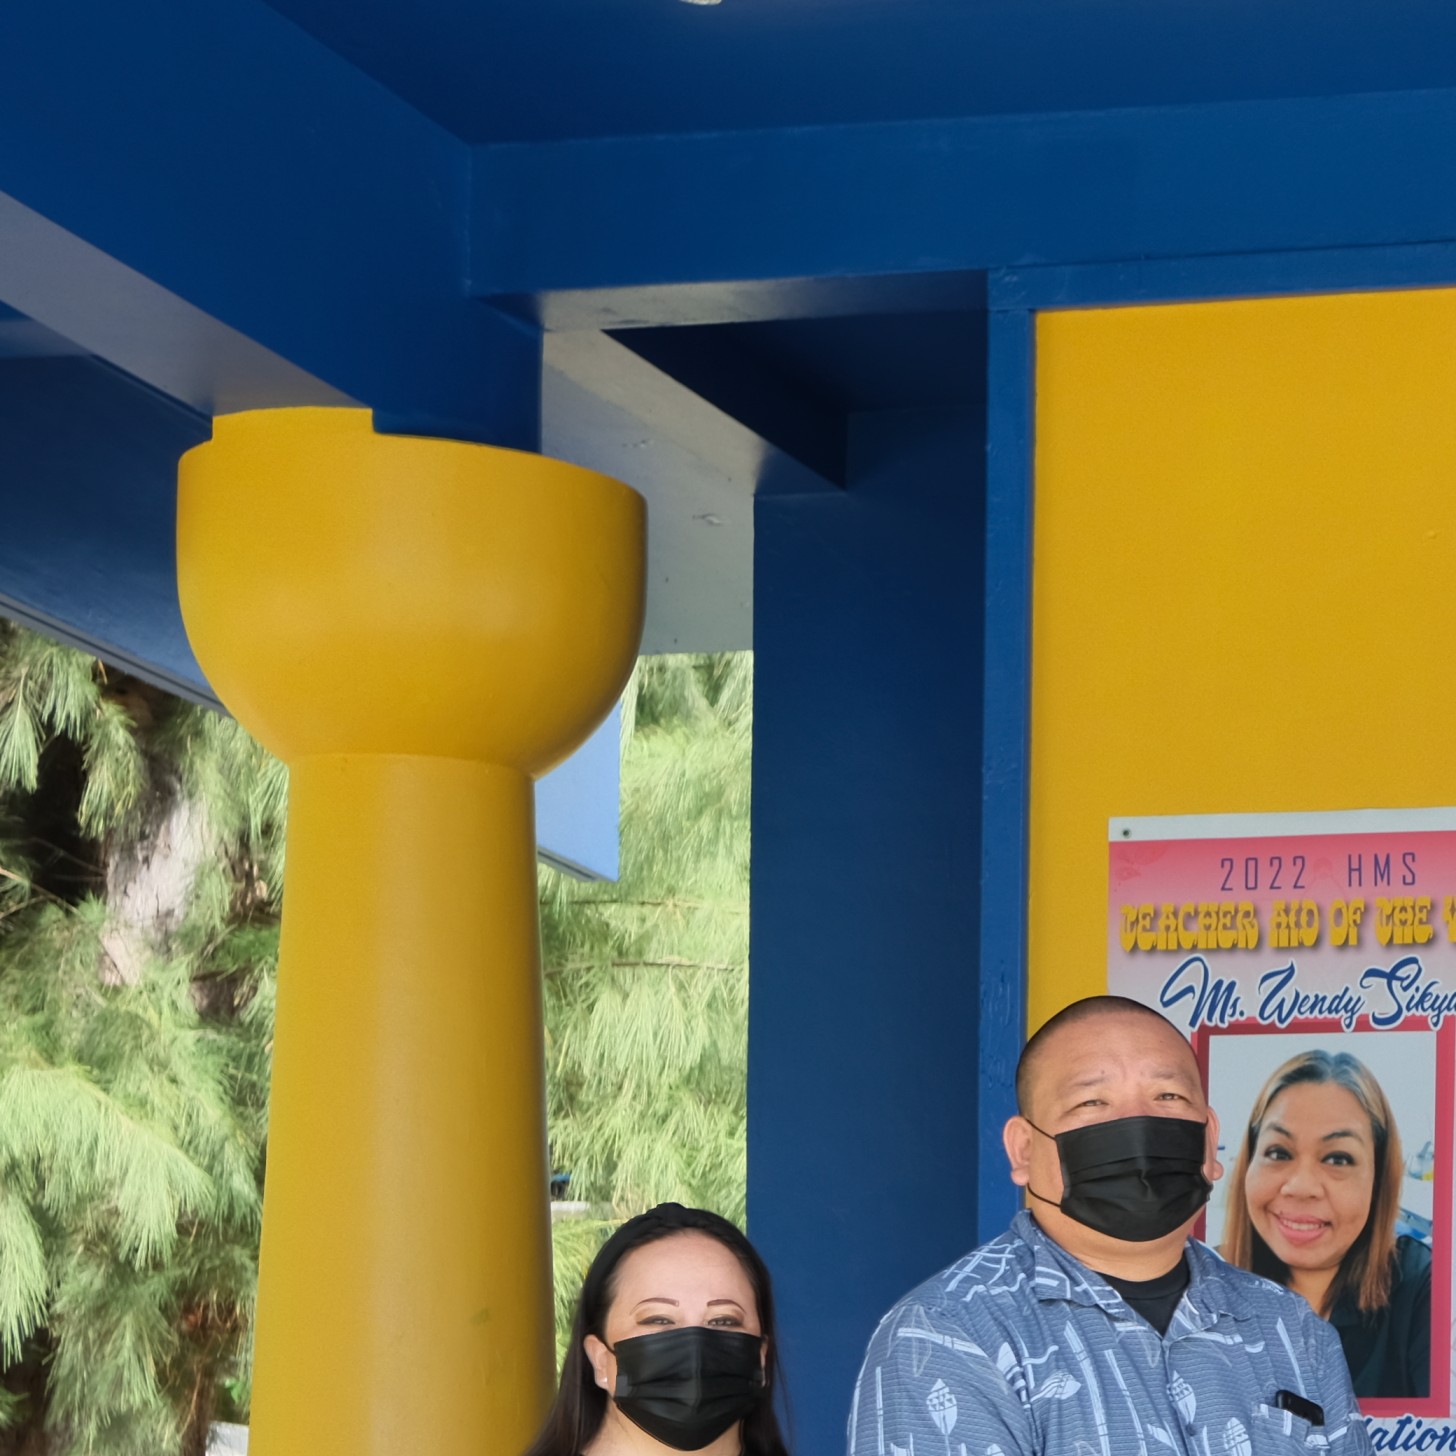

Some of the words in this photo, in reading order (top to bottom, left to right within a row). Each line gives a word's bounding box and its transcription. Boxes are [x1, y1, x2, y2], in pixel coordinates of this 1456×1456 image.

[1221, 856, 1307, 891] 2022
[1348, 852, 1417, 887] HMS
[1120, 902, 1259, 952] TEACHER
[1269, 898, 1319, 947] AID
[1328, 898, 1366, 945] OF
[1375, 896, 1434, 945] THE
[1160, 956, 1245, 1029] Ms.
[1259, 960, 1364, 1031] Wendy
